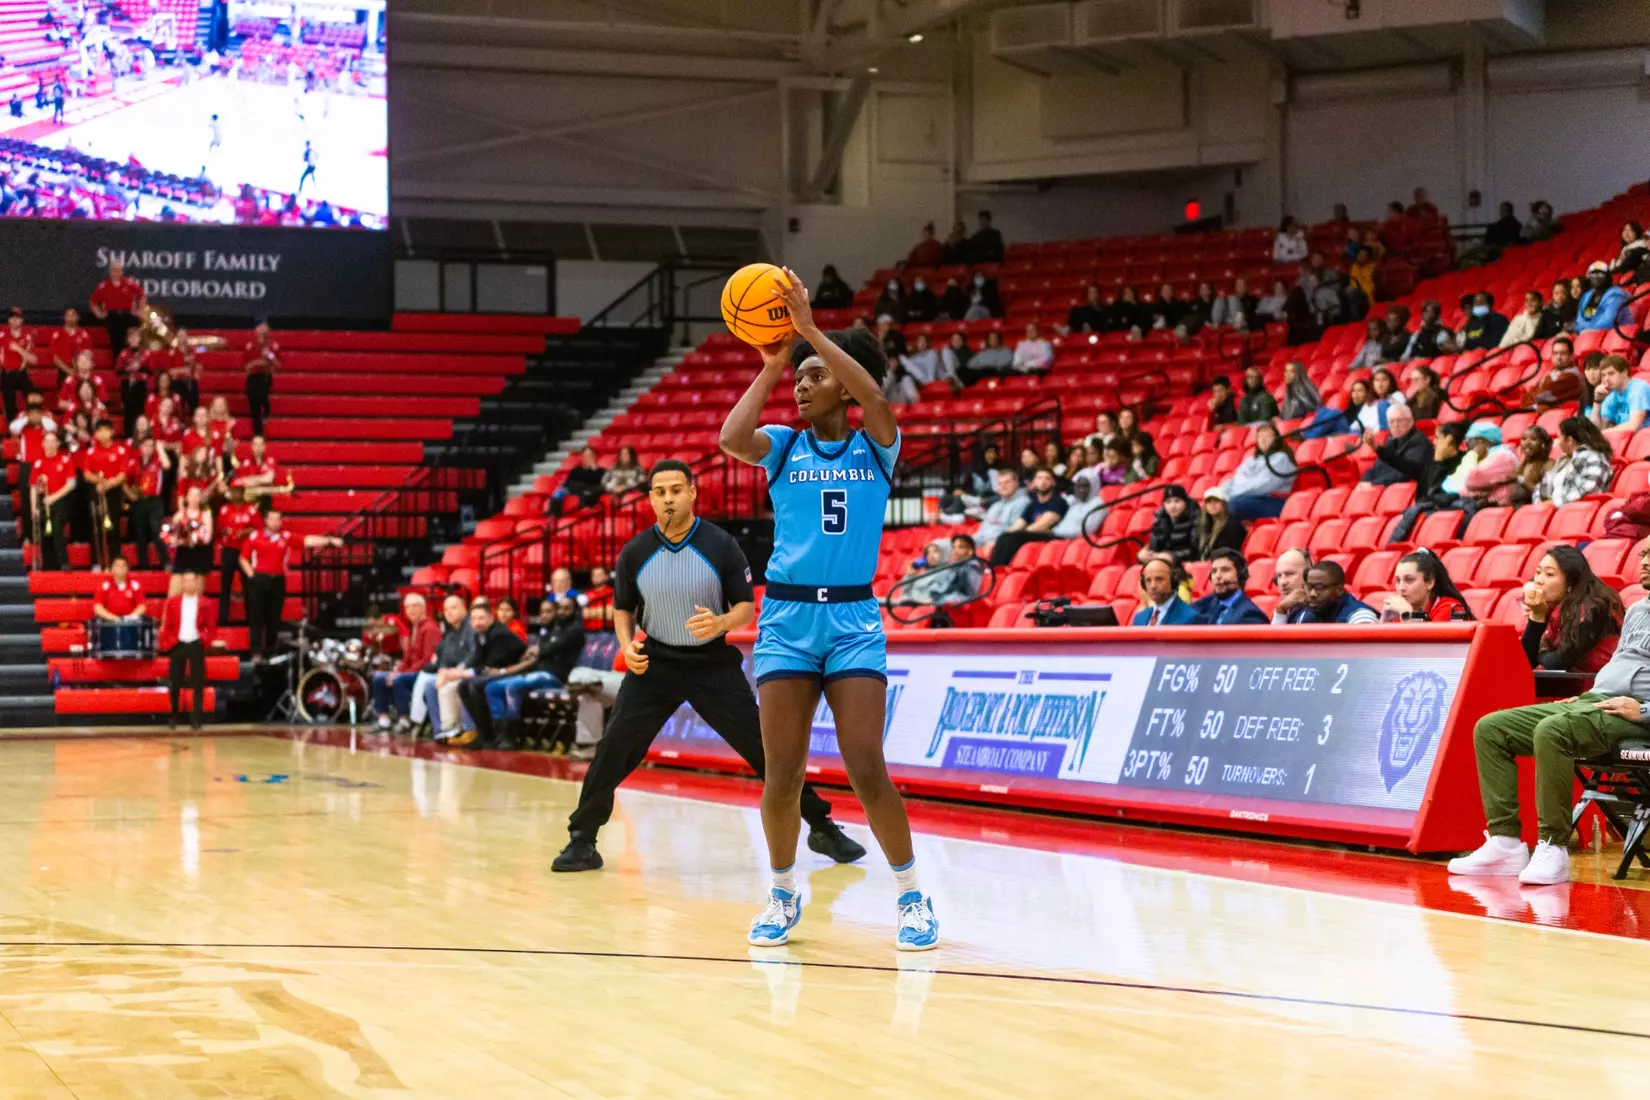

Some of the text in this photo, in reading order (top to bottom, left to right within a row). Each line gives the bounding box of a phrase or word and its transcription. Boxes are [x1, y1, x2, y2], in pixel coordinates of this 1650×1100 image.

[96, 246, 281, 272] SHAROFF FAMILY
[141, 278, 267, 300] DEOBOARD
[789, 469, 876, 484] COLUMBIA
[821, 489, 848, 535] 5
[817, 587, 828, 601] C
[1018, 670, 1036, 685] THE
[1158, 664, 1239, 693] FG% 50
[1249, 663, 1348, 694] OFF REB: 2
[1146, 708, 1224, 739] FT% 50
[1233, 714, 1333, 745] DEF REB: 3
[954, 745, 1053, 772] STEAMBOAT COMPANY
[1124, 749, 1210, 785] 3PT% 50
[1221, 763, 1316, 794] TURNOVERS: 1
